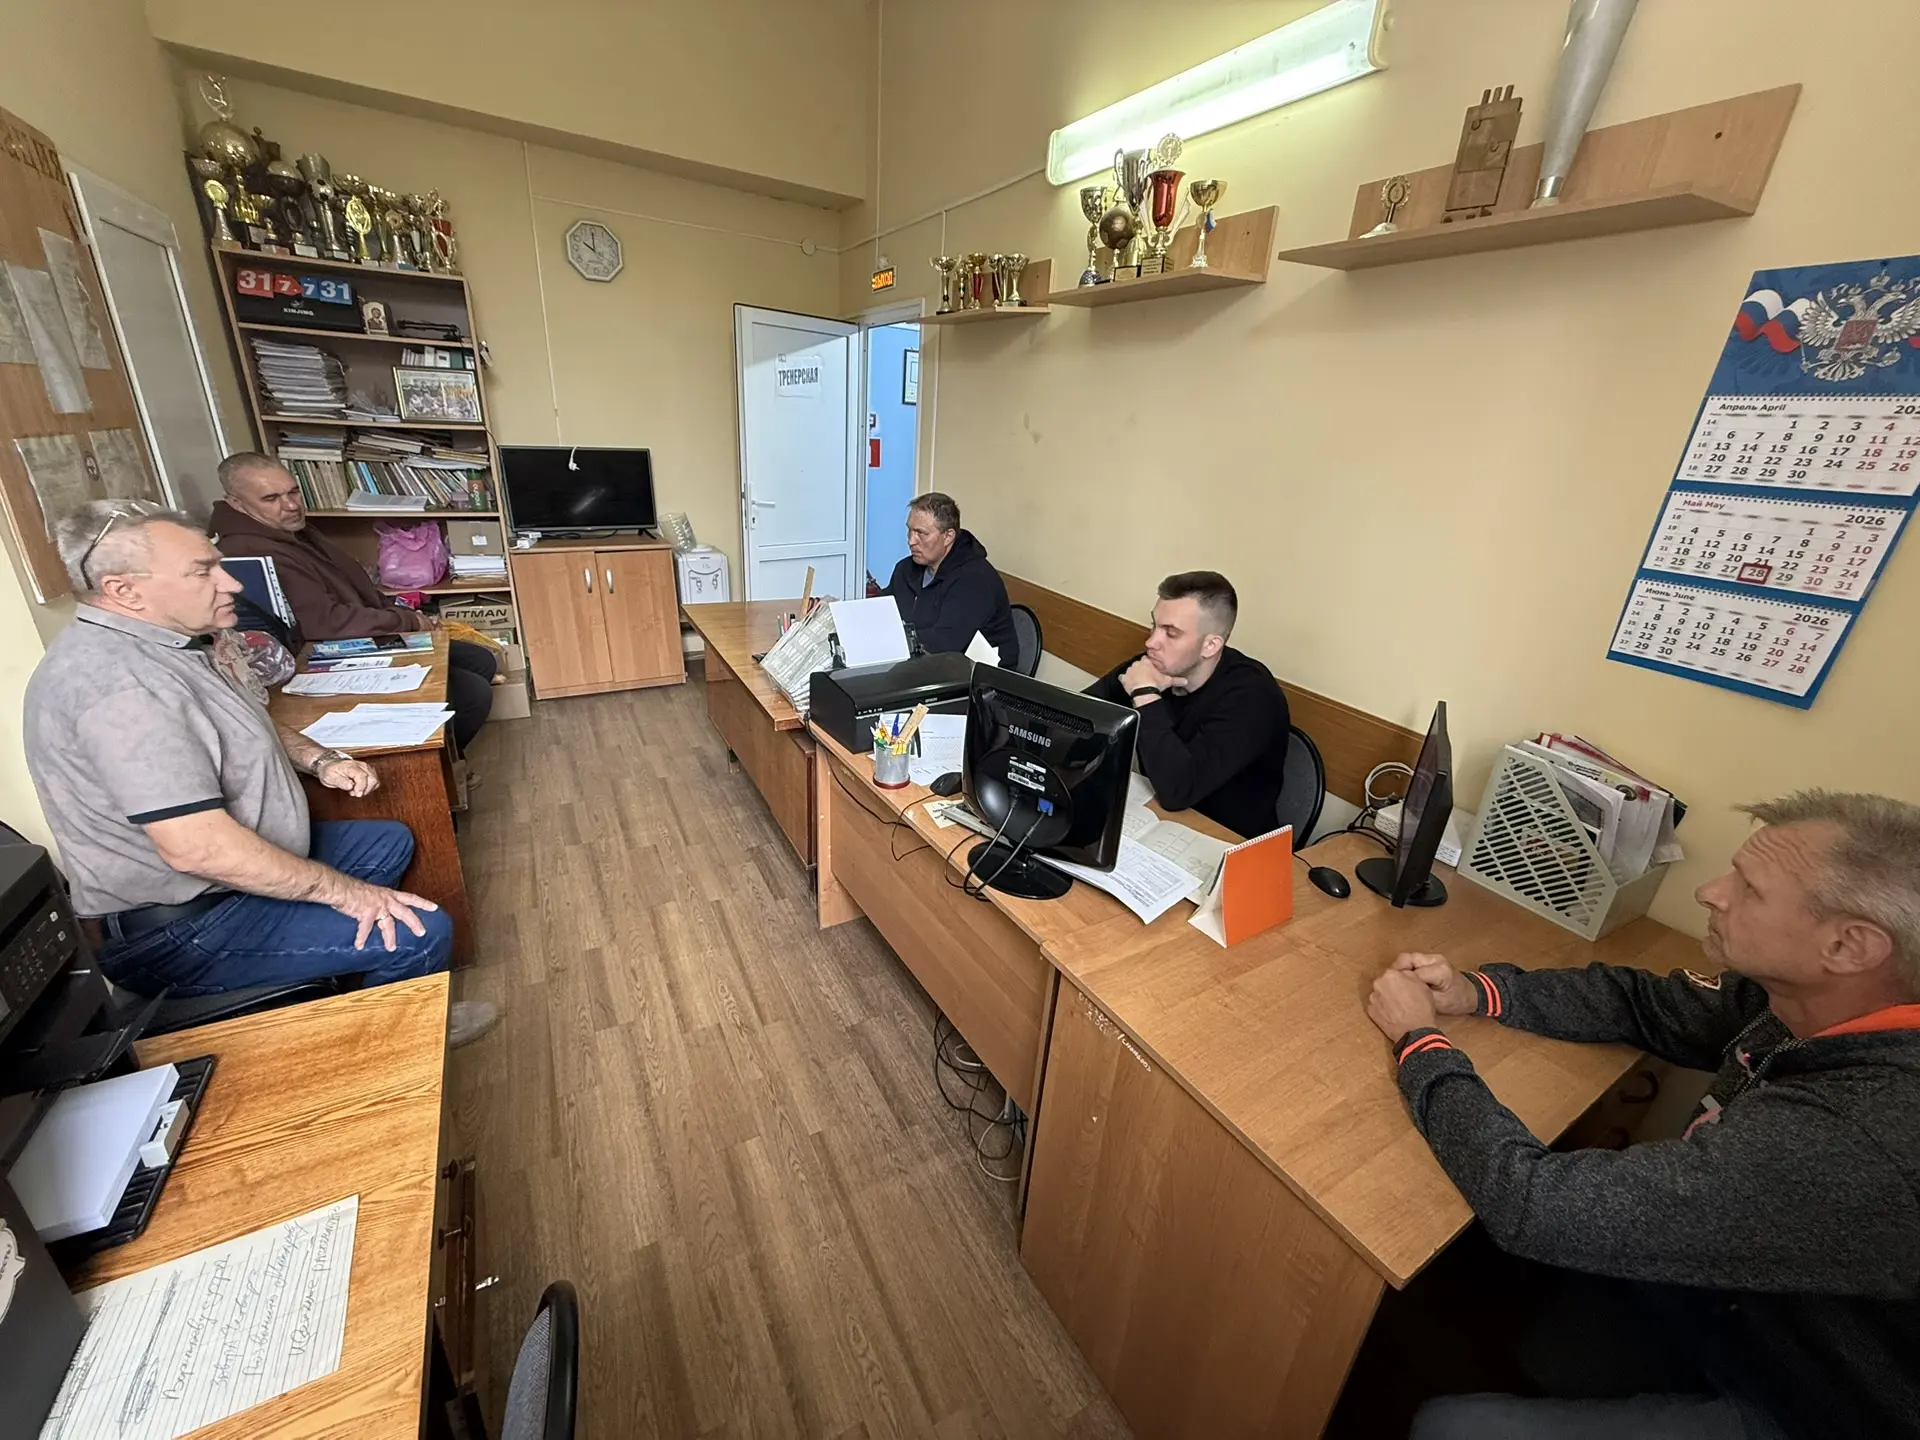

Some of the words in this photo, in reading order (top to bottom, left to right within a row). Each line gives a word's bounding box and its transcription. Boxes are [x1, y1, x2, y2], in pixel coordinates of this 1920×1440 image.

[240, 270, 270, 291] 31
[280, 280, 291, 291] 7
[304, 283, 315, 295] 7
[321, 281, 350, 300] 31
[778, 367, 818, 386] ТРЕНЕРСКАЯ
[1719, 403, 1758, 411] Апрель
[1789, 420, 1798, 429] 1
[1819, 421, 1829, 430] 2
[1851, 421, 1863, 431] 3
[1884, 422, 1895, 431] 4
[1727, 430, 1736, 439] 6
[1754, 432, 1765, 440] 7
[1782, 432, 1793, 441] 8
[1813, 433, 1824, 442] 9
[1835, 434, 1856, 443] 10
[1869, 435, 1888, 444] 11
[1714, 442, 1731, 451] 13
[1741, 443, 1758, 452] 14
[1769, 444, 1788, 453] 15
[1799, 446, 1818, 454] 16
[1829, 447, 1851, 456] 17
[1861, 448, 1883, 457] 18
[1895, 449, 1918, 459] 19
[1708, 454, 1726, 462] 20
[1736, 455, 1753, 464] 21
[1763, 456, 1782, 465] 22
[1793, 458, 1813, 467] 23
[1823, 459, 1843, 468] 24
[1855, 461, 1877, 470] 25
[1888, 462, 1911, 472] 26
[1704, 465, 1722, 473] 27
[1730, 466, 1749, 475] 28
[1758, 468, 1777, 477] 29
[1787, 470, 1807, 479] 30
[1705, 500, 1726, 510] May
[1844, 514, 1886, 526] 2026
[1716, 529, 1727, 538] 5
[1743, 532, 1753, 541] 6
[1771, 535, 1782, 544] 7
[1800, 539, 1810, 548] 8
[1830, 542, 1841, 551] 9
[1852, 545, 1873, 555] 10
[1806, 527, 1815, 536] 1
[1836, 530, 1847, 539] 2
[1868, 533, 1880, 543] 3
[1679, 537, 1694, 545] 11
[1704, 540, 1721, 548] 12
[1730, 543, 1748, 552] 13
[1758, 546, 1775, 555] 14
[1786, 550, 1806, 559] 15
[1816, 553, 1835, 563] 16
[1846, 557, 1867, 566] 17
[1674, 547, 1690, 556] 18
[1699, 550, 1716, 559] 19
[1725, 554, 1743, 563] 20
[1780, 561, 1799, 570] 22
[1810, 565, 1829, 575] 23
[1840, 569, 1859, 579] 24
[1670, 557, 1686, 566] 25
[1695, 561, 1711, 570] 26
[1720, 564, 1739, 573] 27
[1748, 568, 1765, 578] 28
[1775, 572, 1794, 582] 29
[1803, 576, 1824, 586] 30
[1834, 581, 1853, 590] 31
[1645, 587, 1671, 597] Июнь
[1672, 593, 1696, 601] June
[445, 609, 507, 619] FITMAN
[1681, 608, 1690, 616] 2
[1732, 617, 1740, 625] 4
[1758, 622, 1769, 630] 5
[1786, 627, 1796, 635] 6
[1793, 612, 1830, 626] 2026
[1643, 622, 1658, 631] 15
[1666, 627, 1681, 636] 16
[1690, 632, 1706, 640] 17
[1715, 637, 1732, 646] 18
[1741, 642, 1757, 651] 19
[1766, 647, 1785, 657] 20
[1795, 653, 1811, 663] 21
[1694, 621, 1711, 630] 10
[1720, 626, 1735, 636] 11
[1745, 632, 1763, 640] 12
[1772, 637, 1790, 646] 13
[1799, 642, 1817, 652] 14
[1634, 641, 1649, 650] 29
[1657, 646, 1673, 656] 30
[1638, 632, 1653, 640] 22
[1662, 637, 1677, 645] 23
[1685, 642, 1701, 650] 24
[1710, 647, 1727, 656] 25
[1735, 652, 1752, 662] 26
[1761, 658, 1780, 668] 27
[1787, 664, 1805, 674] 28
[1008, 724, 1052, 748] SAMSUNG
